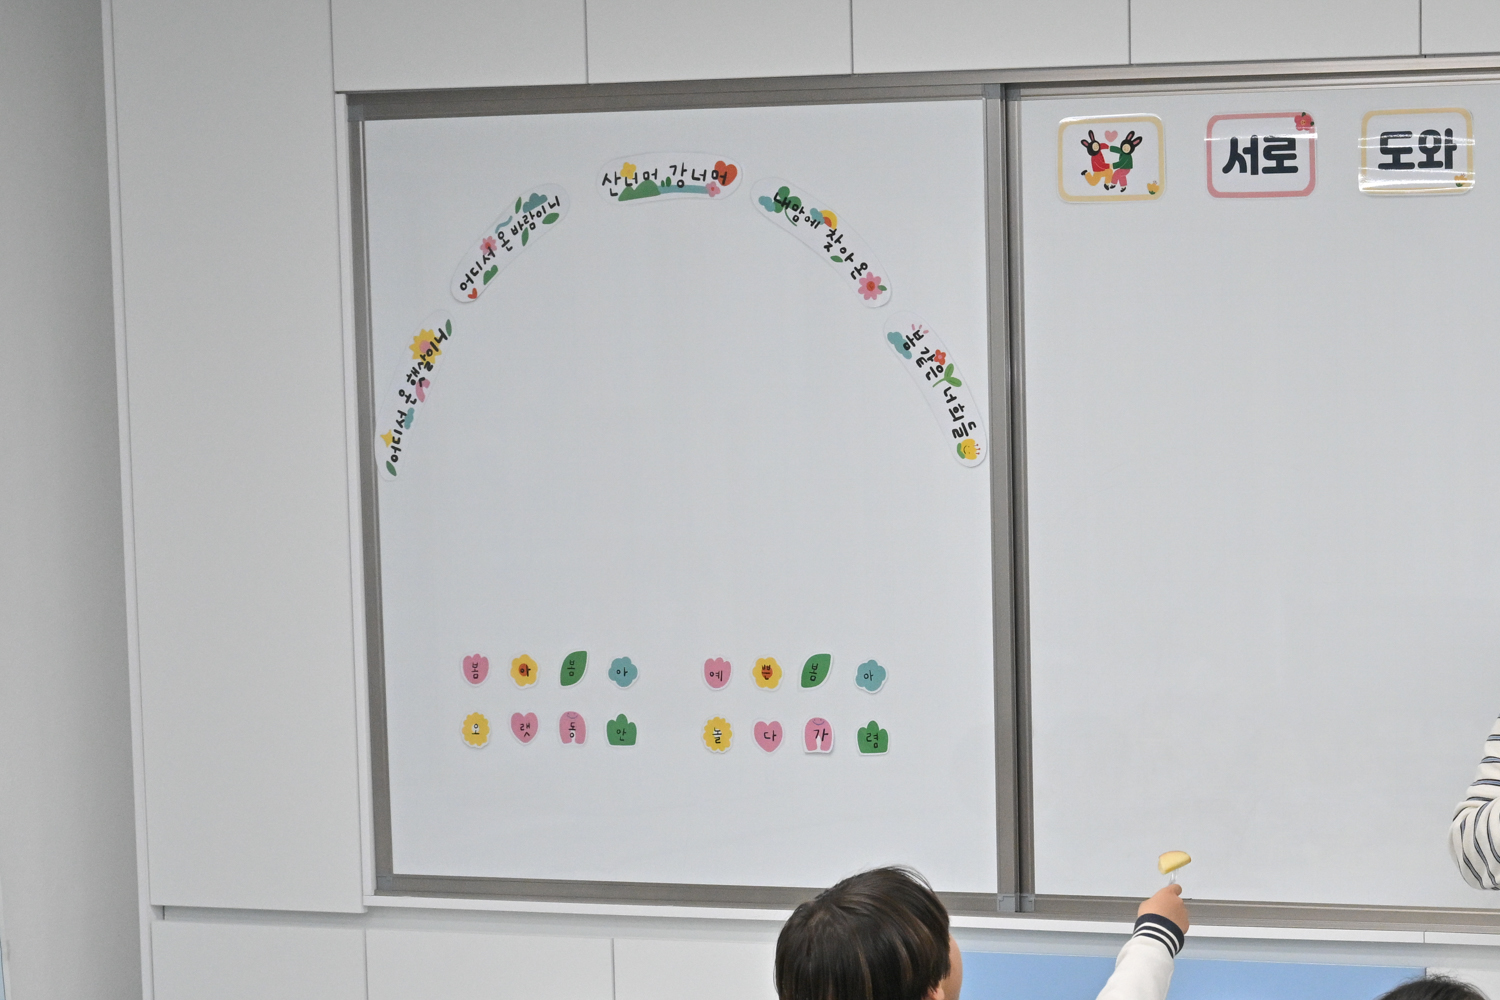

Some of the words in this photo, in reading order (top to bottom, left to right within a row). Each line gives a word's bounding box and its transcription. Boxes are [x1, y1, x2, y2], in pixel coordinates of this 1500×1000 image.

[1221, 134, 1299, 176] 서로
[1377, 129, 1458, 170] 도와
[460, 247, 495, 291] 어디서
[498, 231, 513, 251] 온
[511, 196, 560, 235] 바람이니
[406, 328, 448, 387] 햇살이니
[903, 329, 924, 351] 봄
[915, 347, 944, 380] 같은
[943, 387, 977, 439] 너희들
[399, 389, 417, 405] 온
[391, 410, 407, 462] 어디서
